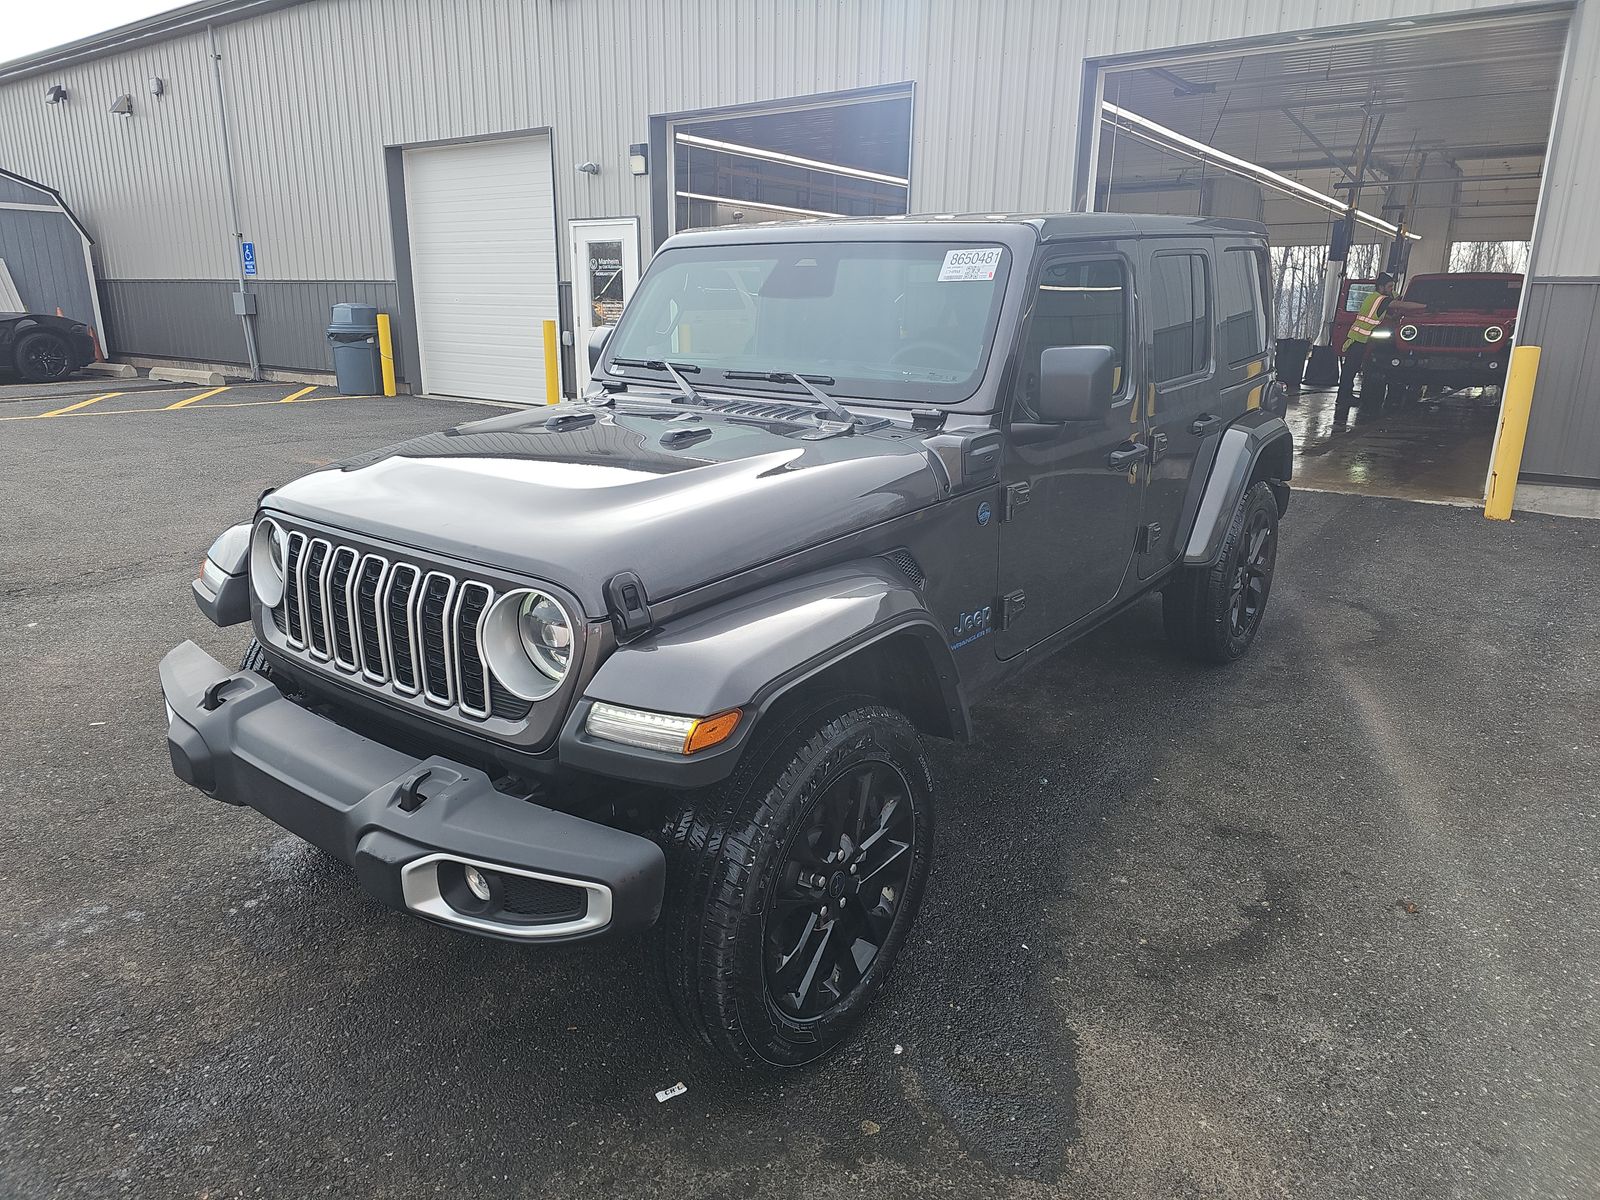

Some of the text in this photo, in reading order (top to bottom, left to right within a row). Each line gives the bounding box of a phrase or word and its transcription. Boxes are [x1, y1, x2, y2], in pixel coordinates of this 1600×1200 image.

[950, 251, 1001, 266] 8650481
[953, 606, 992, 636] Jeep
[950, 630, 985, 650] WRANGLER
